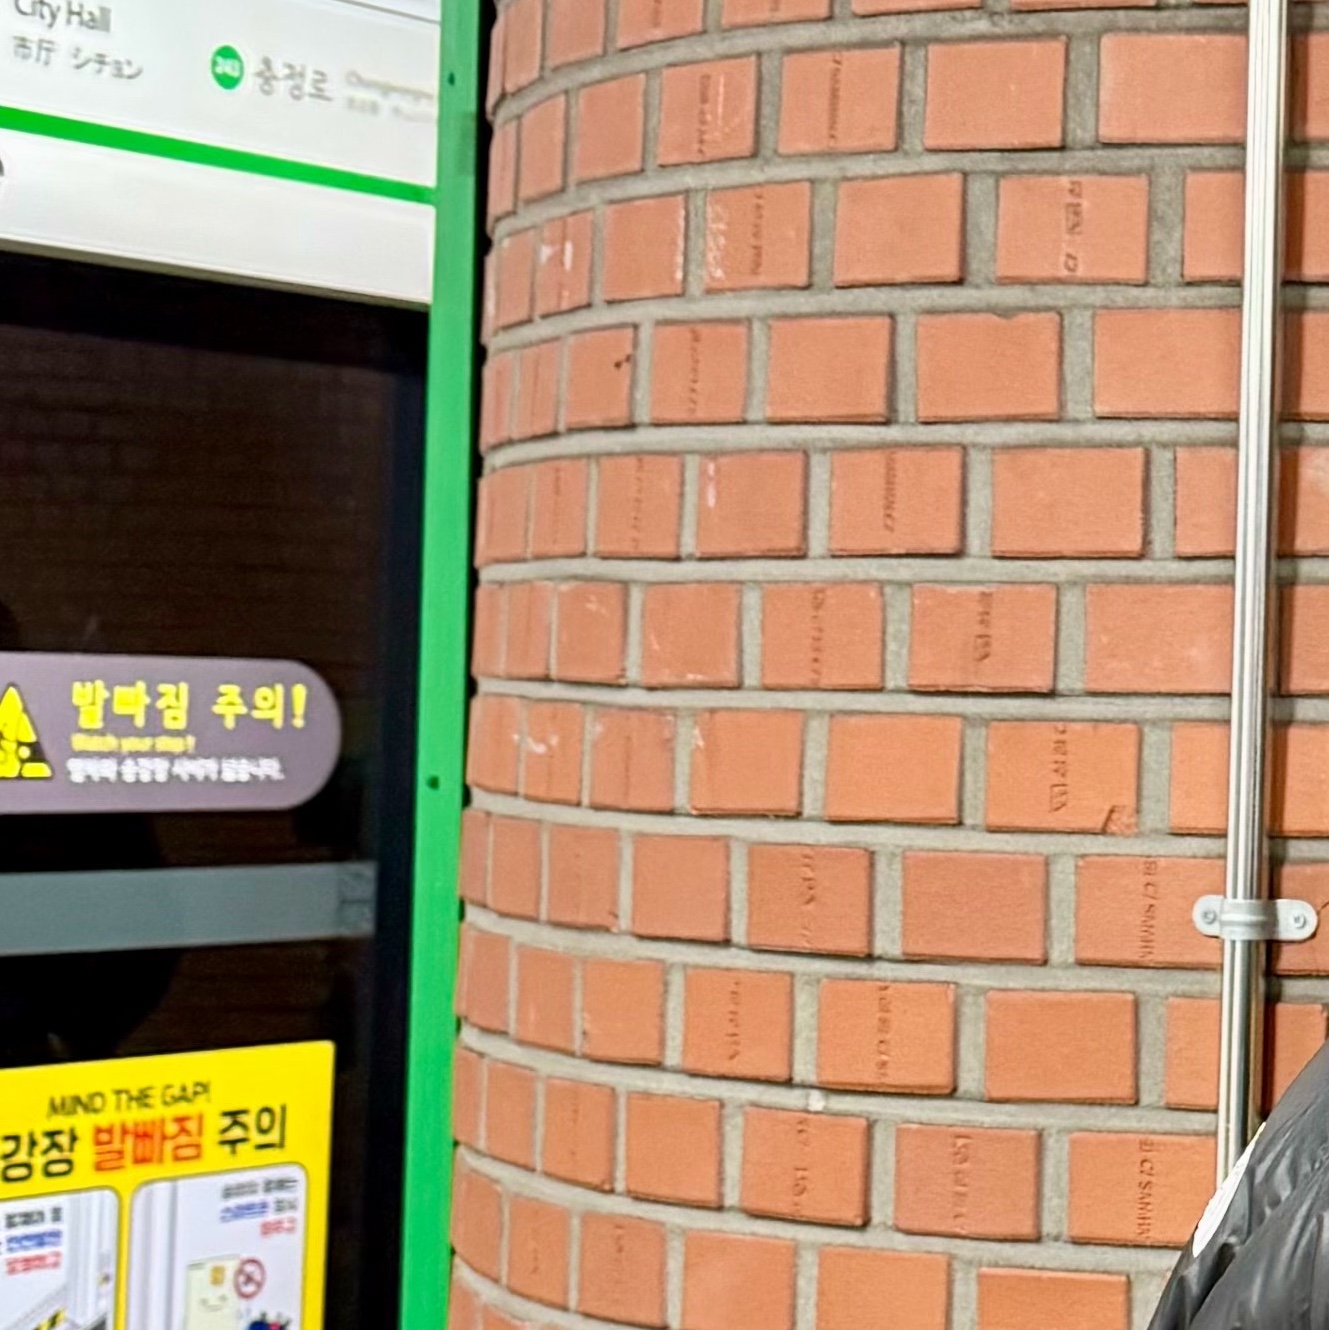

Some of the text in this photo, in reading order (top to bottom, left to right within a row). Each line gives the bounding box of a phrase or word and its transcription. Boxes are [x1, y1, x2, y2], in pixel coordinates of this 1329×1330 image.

[253, 56, 332, 102] 충정로
[211, 682, 307, 729] 주의!
[46, 1091, 106, 1119] MIND
[112, 1086, 155, 1111] THE
[93, 1112, 204, 1174] 발빠짐
[218, 1104, 287, 1156] 주의
